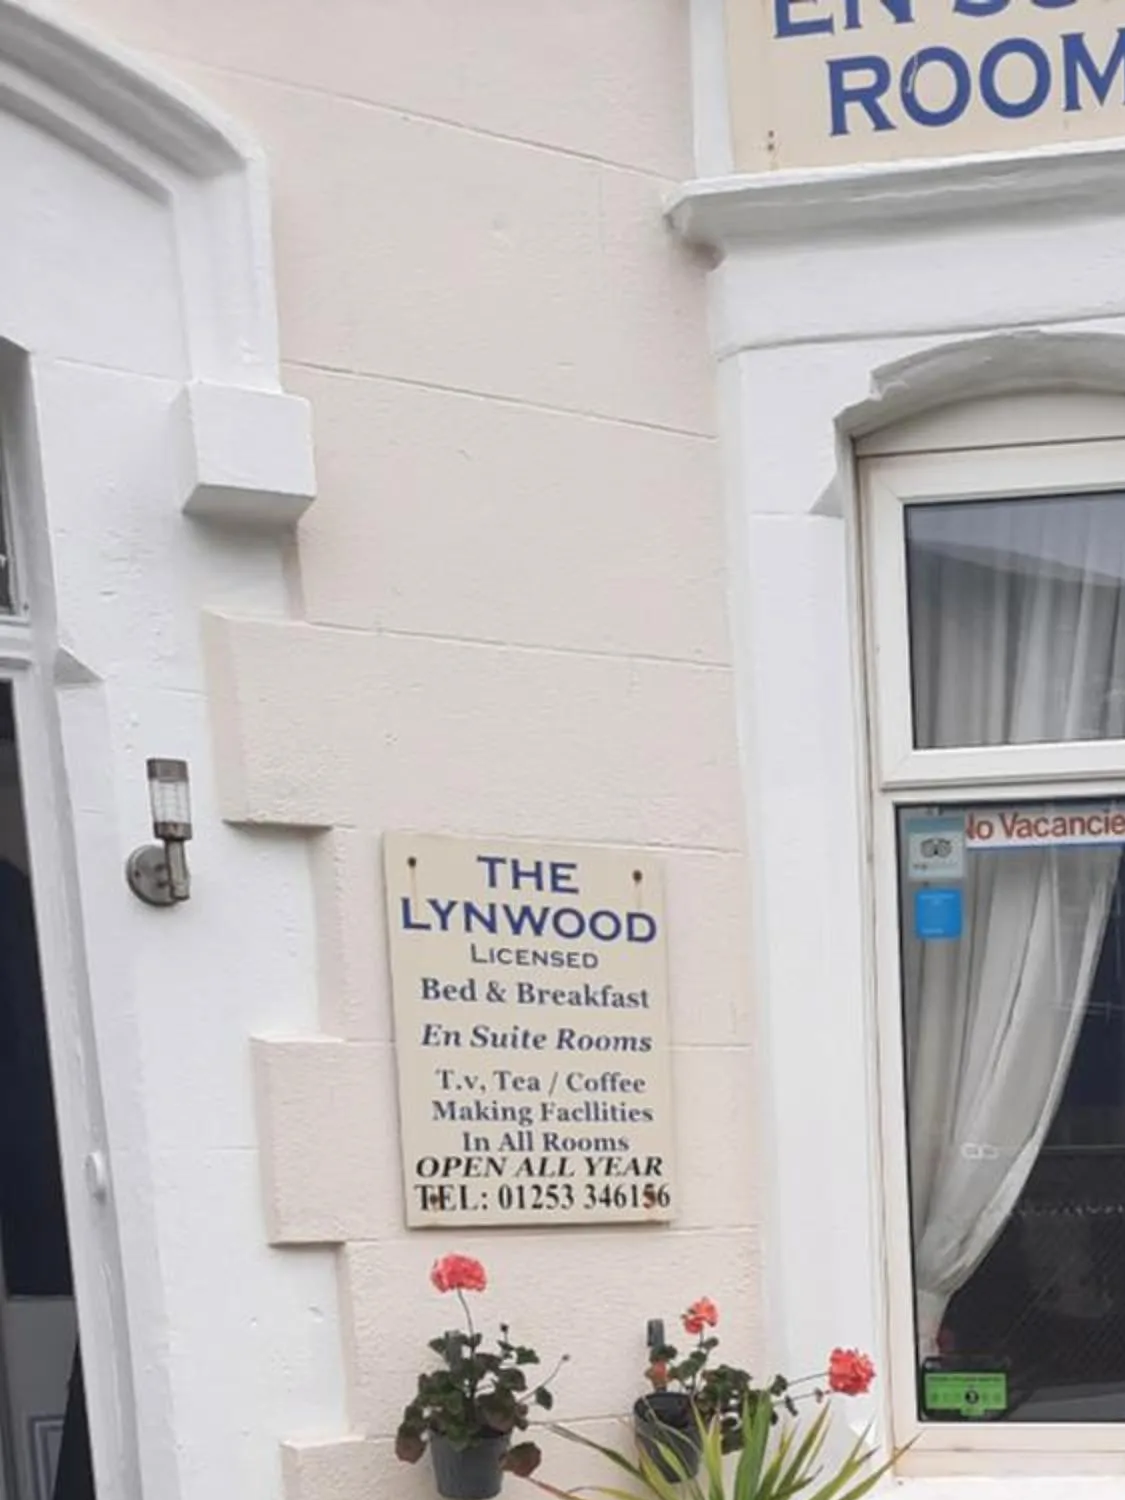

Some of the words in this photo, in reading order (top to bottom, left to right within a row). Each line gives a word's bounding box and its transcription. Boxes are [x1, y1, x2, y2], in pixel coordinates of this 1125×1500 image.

[477, 855, 580, 894] THE
[400, 897, 657, 943] LYNWOOD
[420, 977, 477, 1002] Bed
[485, 980, 507, 1003] &
[517, 982, 650, 1009] Breakfast
[421, 1023, 462, 1047] En
[470, 1024, 547, 1050] Suite
[556, 1028, 653, 1053] Rooms
[493, 1070, 541, 1092] Tea
[548, 1071, 559, 1097] /
[565, 1072, 647, 1094] Coffee
[431, 1101, 533, 1127] Making
[462, 1132, 490, 1152] In
[499, 1131, 534, 1152] All
[542, 1133, 630, 1152] Rooms
[415, 1156, 507, 1178] OPEN
[514, 1157, 576, 1178] ALL
[583, 1156, 664, 1177] YEAR
[414, 1184, 488, 1212] TEL:
[498, 1184, 575, 1210] 01253
[583, 1183, 671, 1209] 346156
